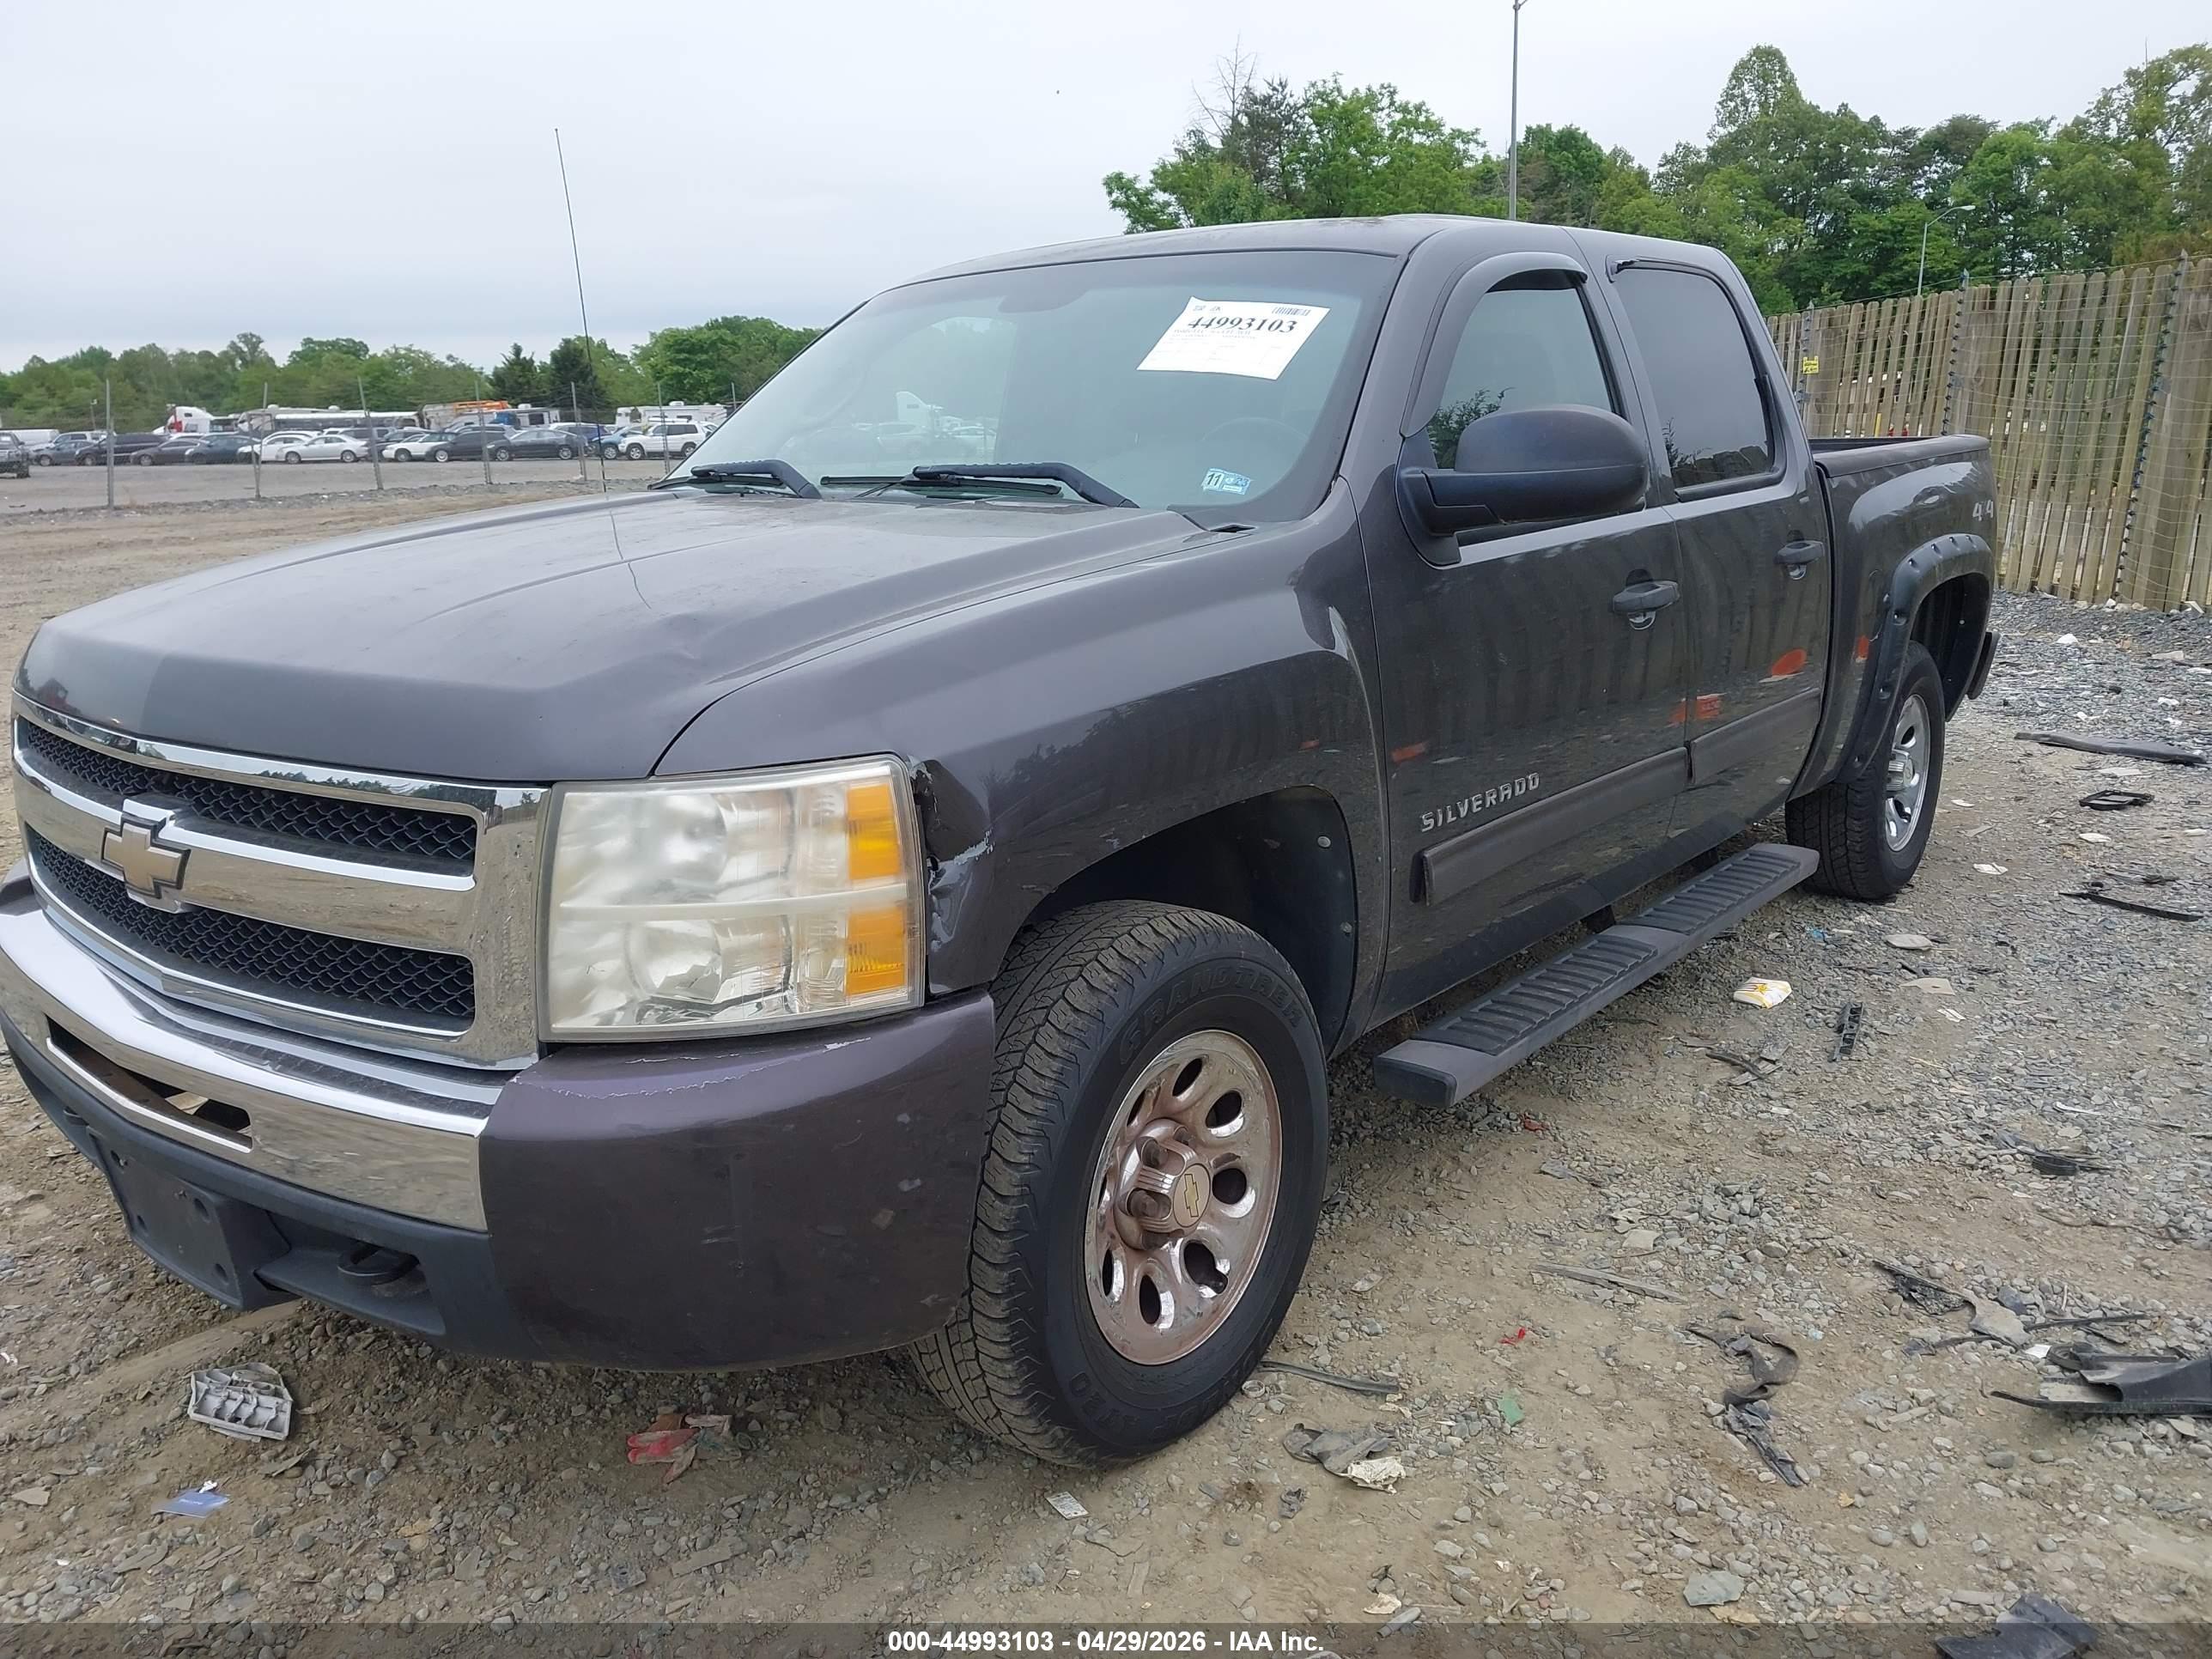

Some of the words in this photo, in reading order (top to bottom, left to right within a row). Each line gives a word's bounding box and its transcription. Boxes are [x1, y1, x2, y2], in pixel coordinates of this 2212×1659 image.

[1188, 316, 1298, 333] 44993103
[1207, 472, 1222, 486] 11
[1421, 772, 1540, 832] SILVERADO
